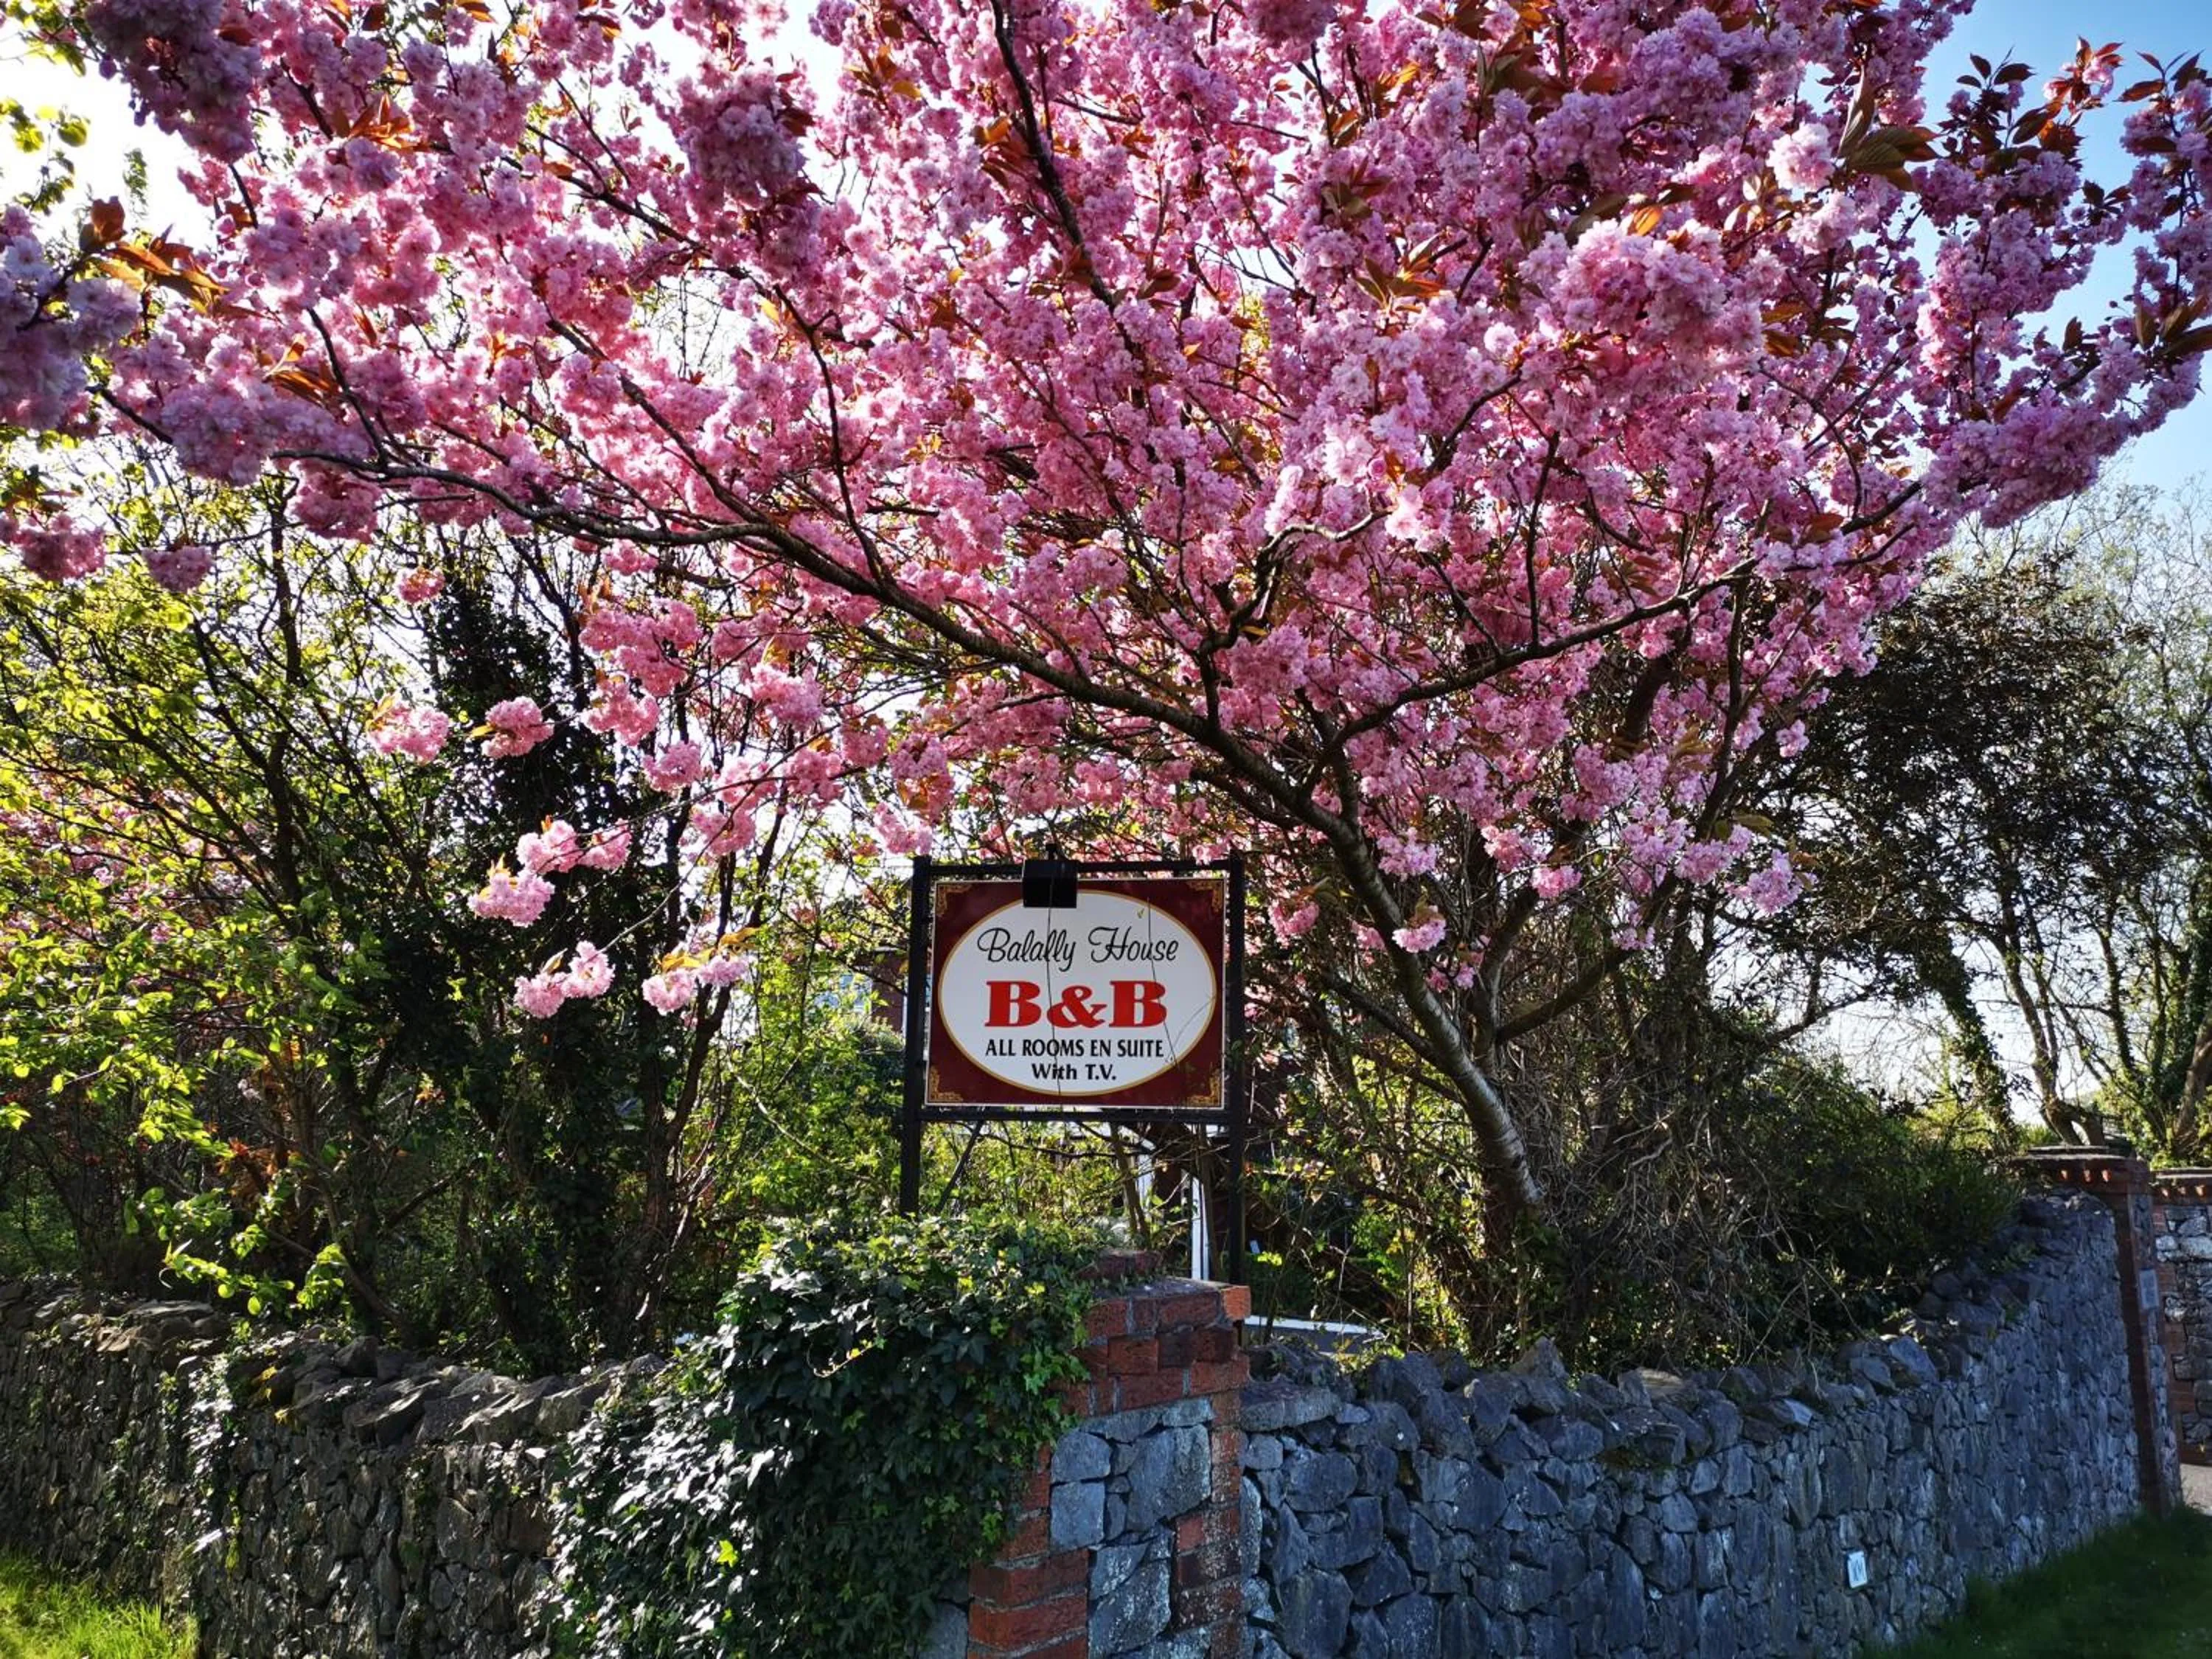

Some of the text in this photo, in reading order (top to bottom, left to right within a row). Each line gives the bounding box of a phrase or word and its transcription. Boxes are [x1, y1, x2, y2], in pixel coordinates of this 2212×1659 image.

[977, 926, 1179, 972] Balally House
[984, 981, 1167, 1028] B&B
[986, 1040, 1164, 1057] ALL ROOMS EN SUITE
[1032, 1065, 1116, 1080] With T.V.
